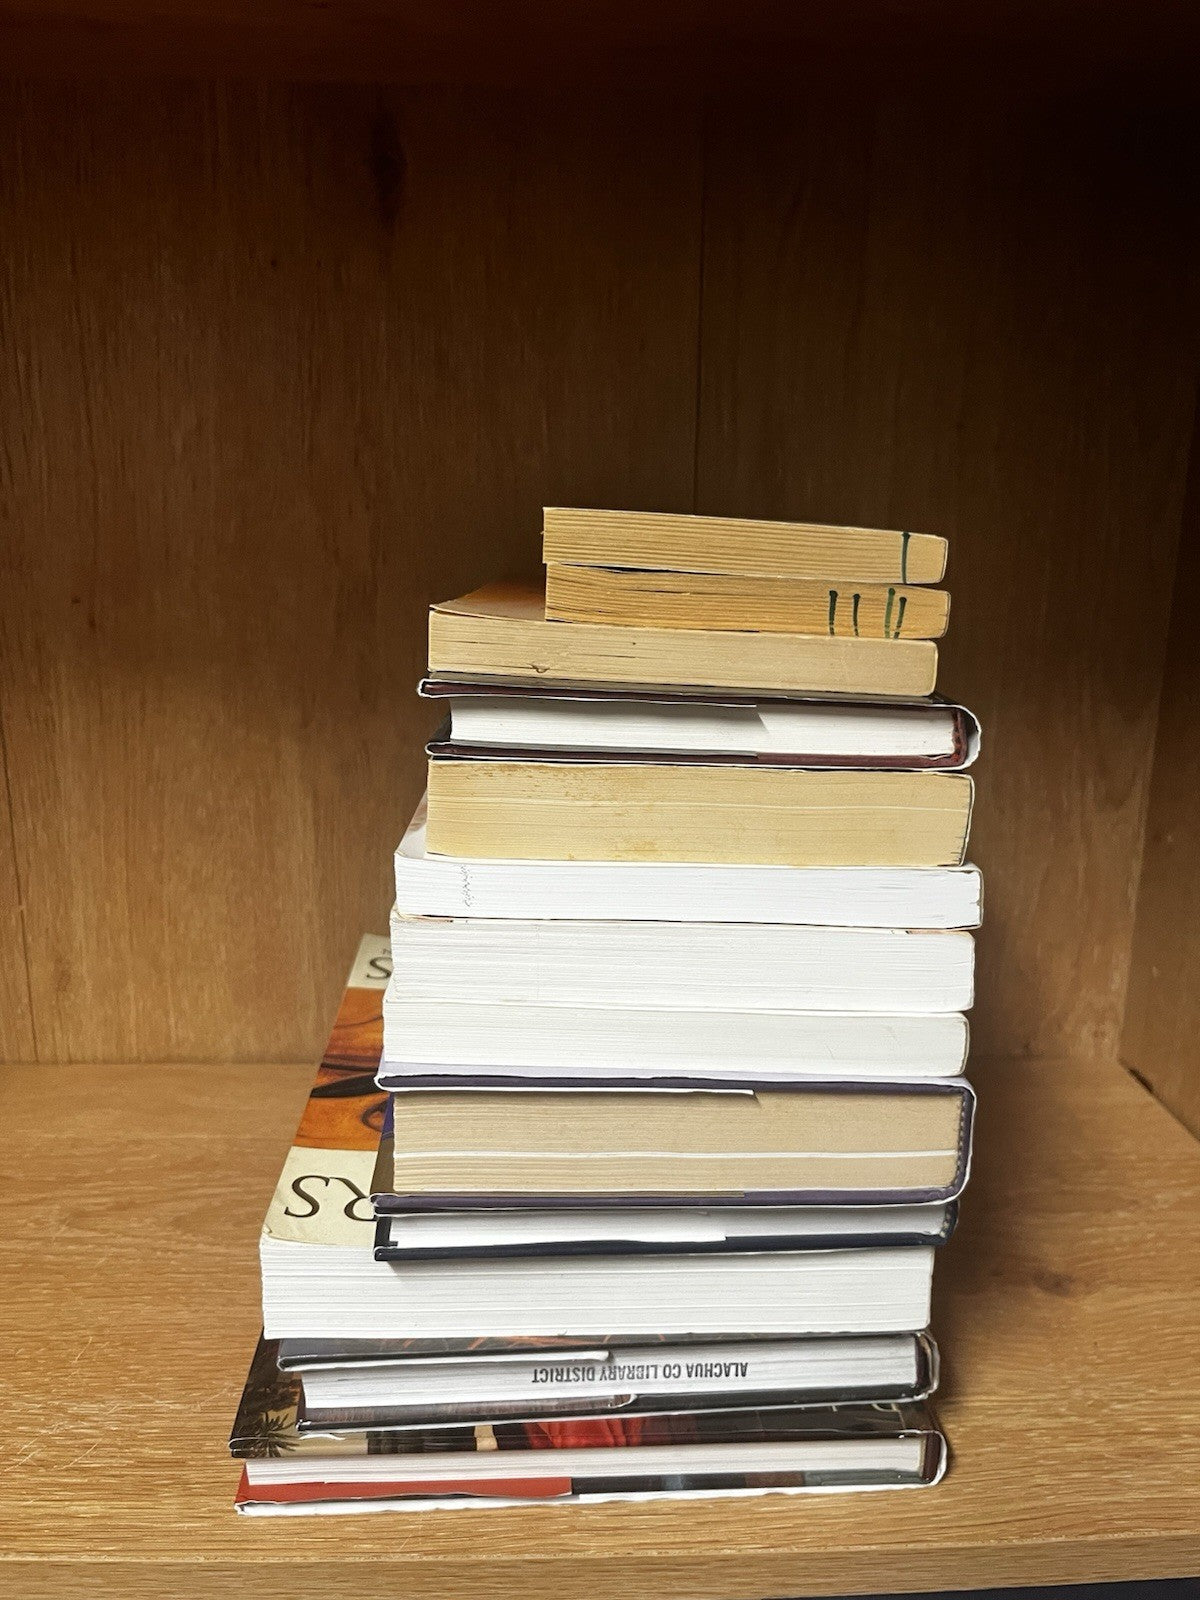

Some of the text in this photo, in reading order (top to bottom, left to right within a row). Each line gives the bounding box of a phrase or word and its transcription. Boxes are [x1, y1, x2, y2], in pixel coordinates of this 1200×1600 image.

[532, 1362, 749, 1383] ALACHUA CO LIBRARY DISTRICT
